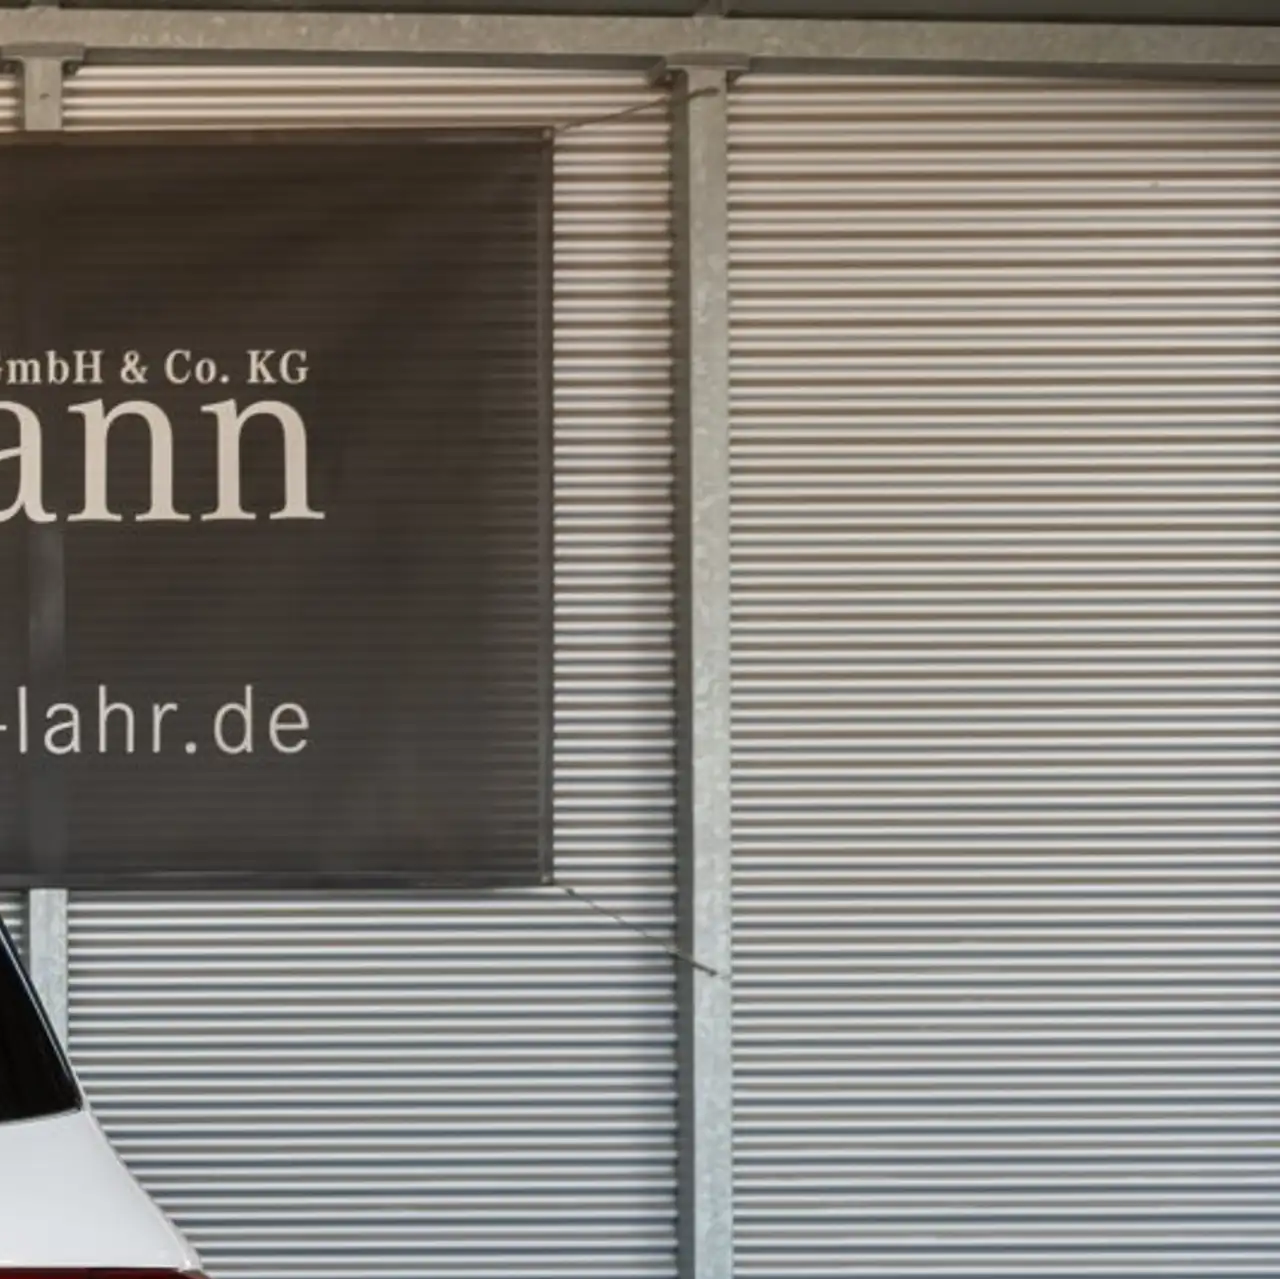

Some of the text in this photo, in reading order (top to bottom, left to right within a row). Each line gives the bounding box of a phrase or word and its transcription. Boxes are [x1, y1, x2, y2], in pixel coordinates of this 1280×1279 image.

[120, 351, 148, 385] &
[165, 350, 230, 385] Co.
[248, 350, 308, 385] KG
